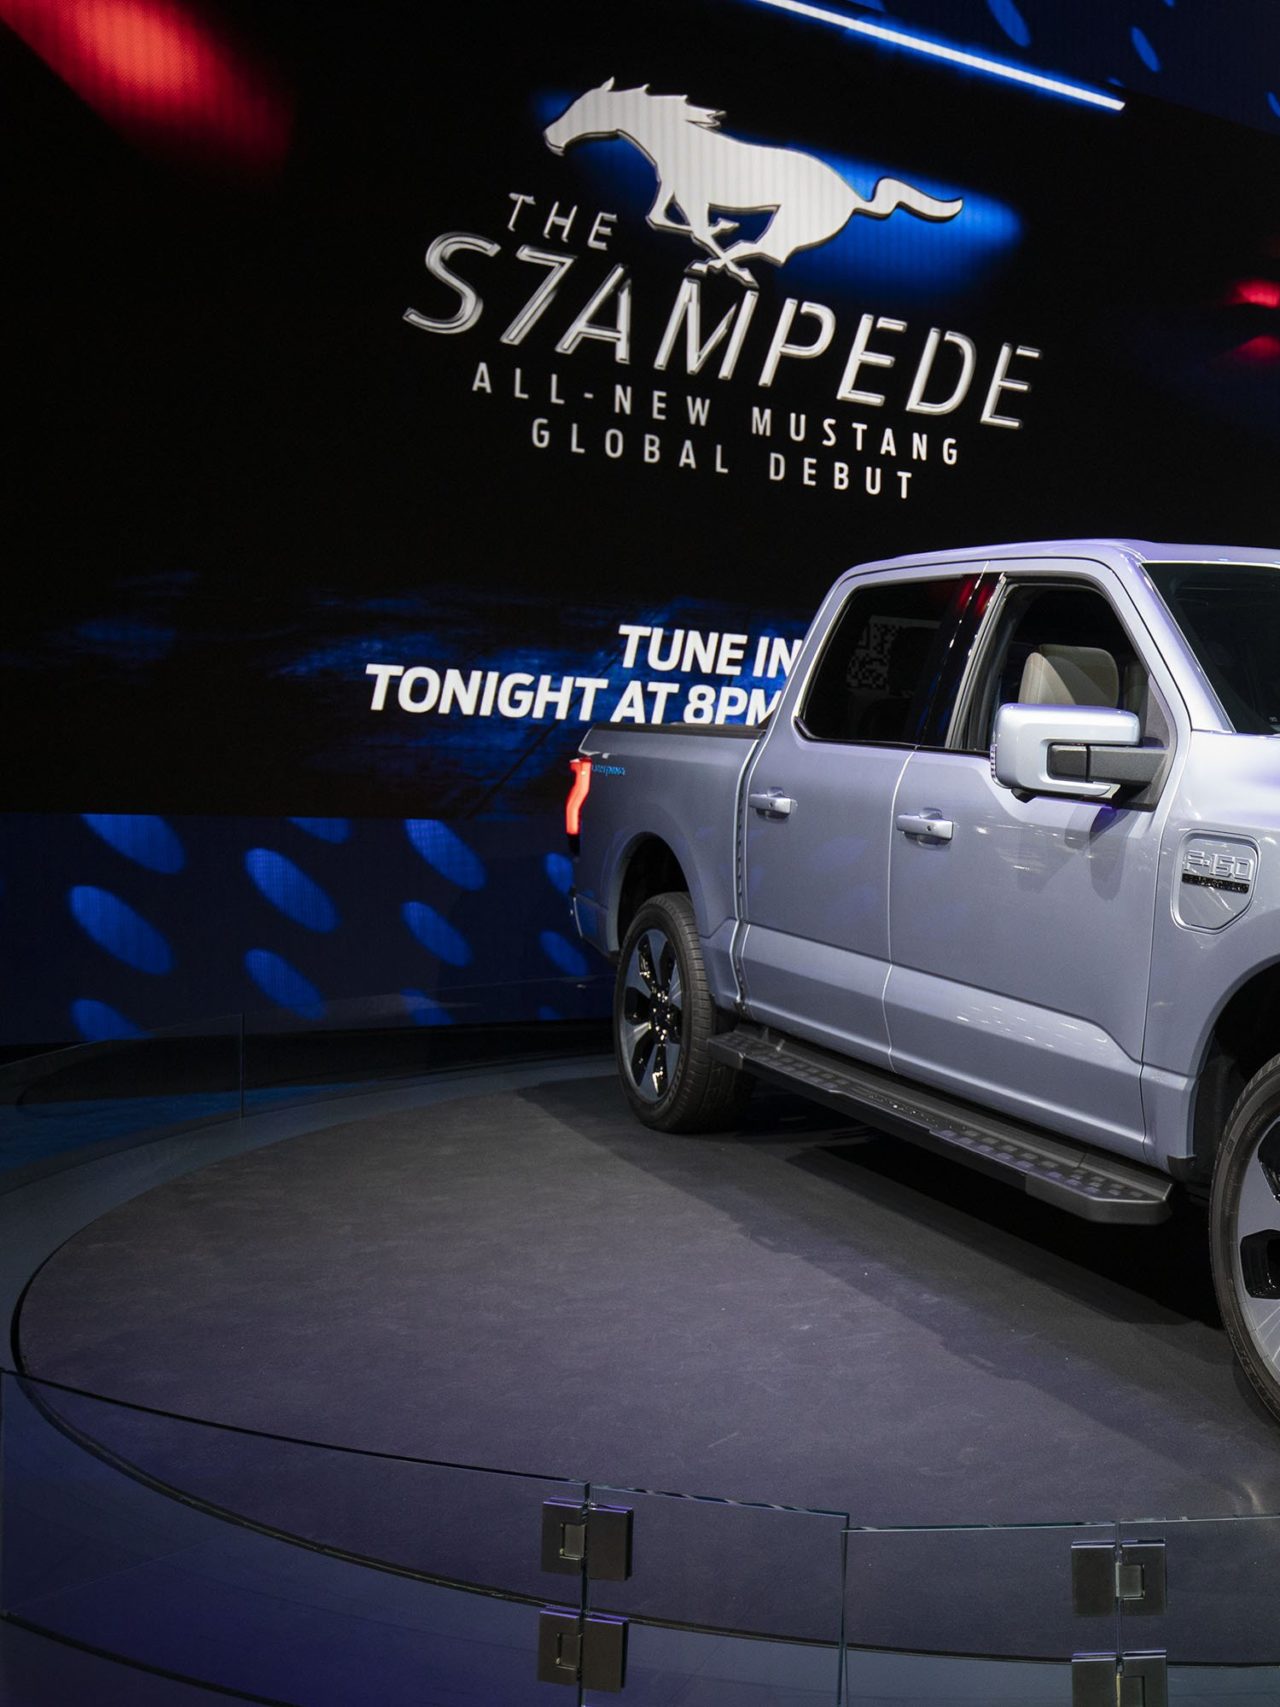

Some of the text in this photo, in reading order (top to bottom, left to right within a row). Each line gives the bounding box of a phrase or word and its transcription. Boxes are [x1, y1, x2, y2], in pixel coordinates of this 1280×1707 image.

[507, 192, 618, 251] THE
[402, 231, 1043, 430] S7AMPEDE
[472, 361, 958, 466] ALL-NEW MUSTANG
[531, 417, 913, 500] GLOBAL DEBUT
[618, 624, 803, 679] TUNE IN
[365, 664, 782, 727] TONIGHT AT 8PM
[1183, 849, 1255, 882] F-150
